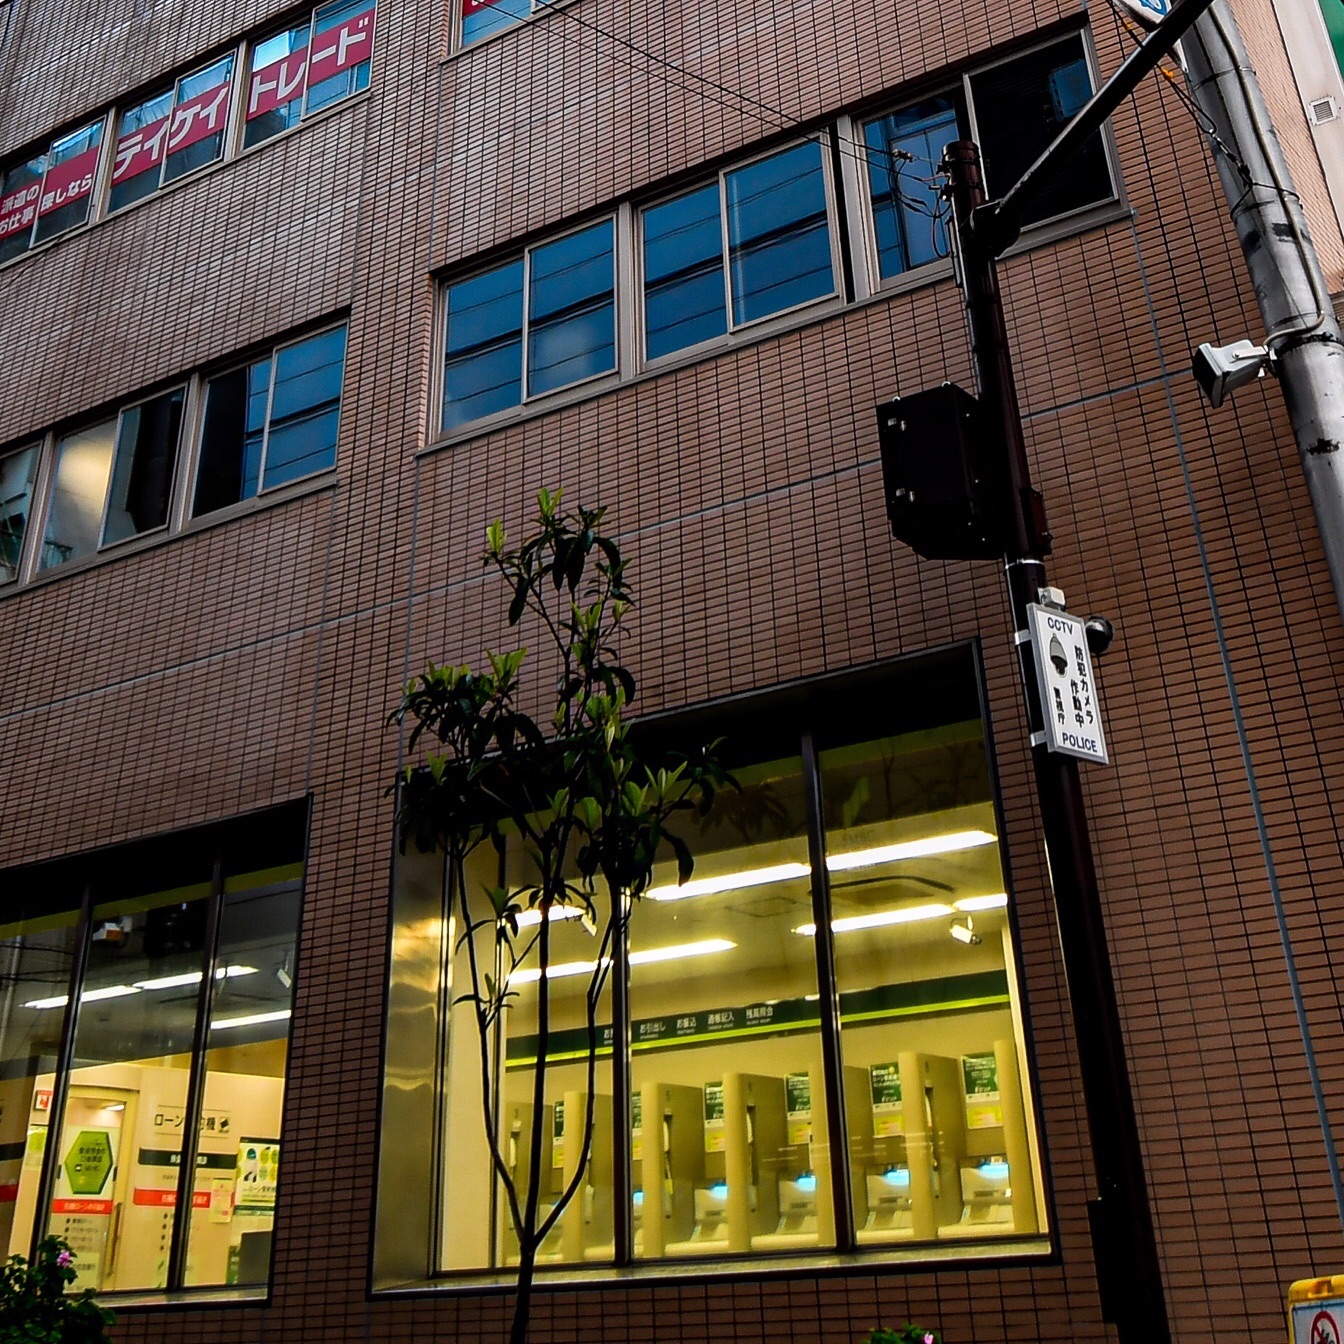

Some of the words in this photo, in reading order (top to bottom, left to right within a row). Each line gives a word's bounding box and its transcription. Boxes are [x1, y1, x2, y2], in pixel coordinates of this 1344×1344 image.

[41, 173, 94, 213] 探しなら
[113, 16, 371, 179] テイケイトレード
[1, 184, 40, 217] 派遣の
[1047, 616, 1074, 636] CCTV
[1070, 678, 1085, 729] 作動中
[1074, 644, 1094, 725] 防犯カメラ
[1062, 731, 1098, 753] POLICE
